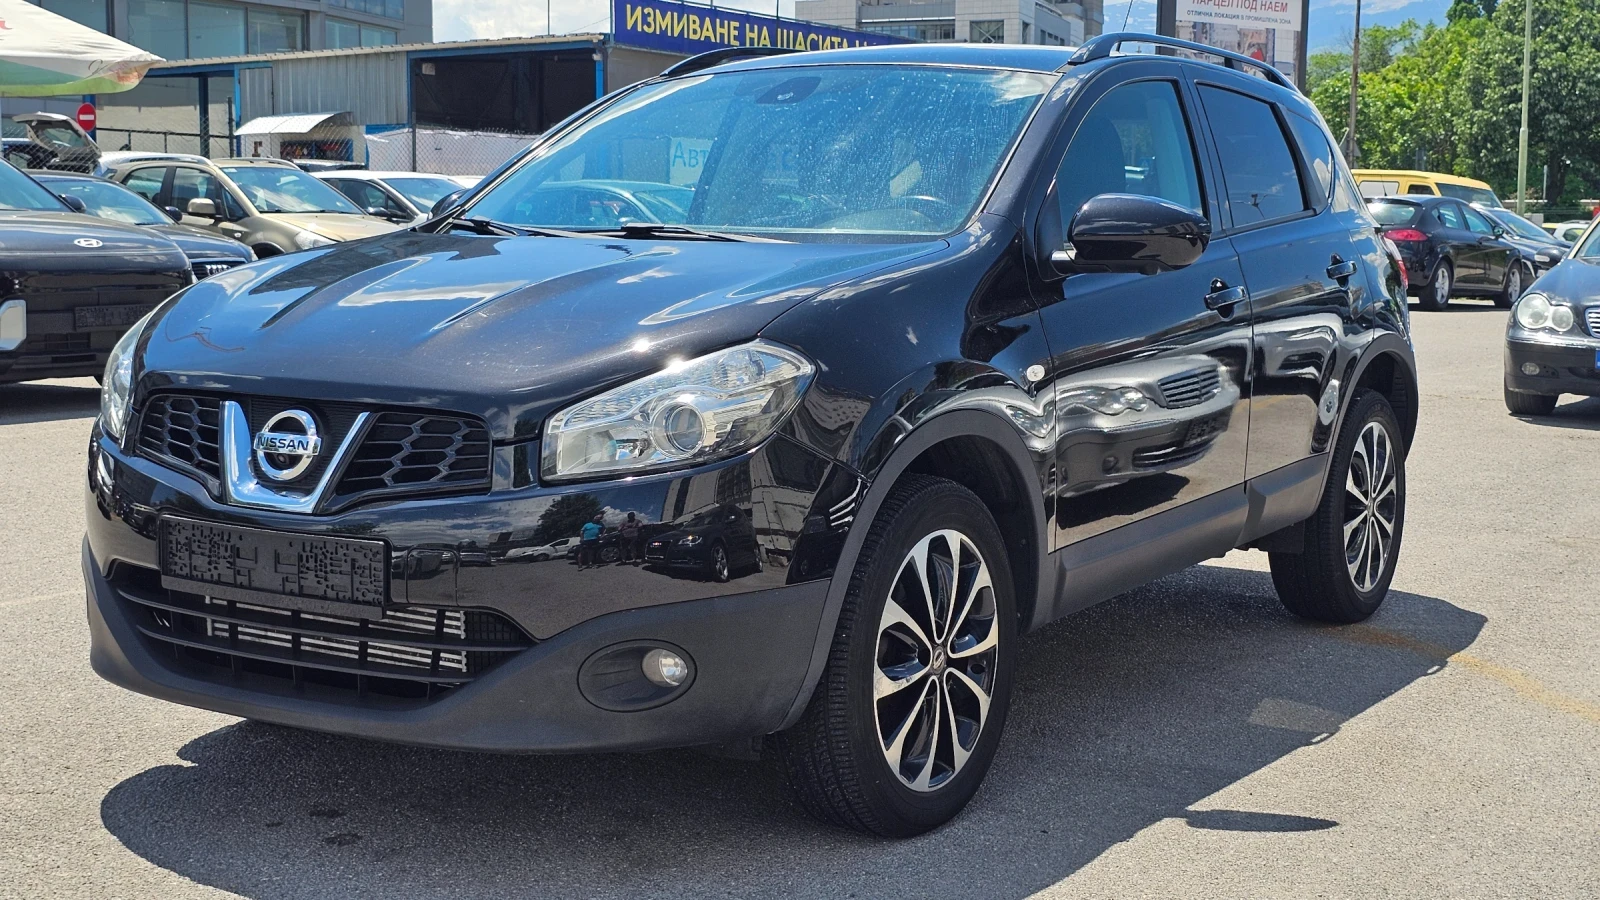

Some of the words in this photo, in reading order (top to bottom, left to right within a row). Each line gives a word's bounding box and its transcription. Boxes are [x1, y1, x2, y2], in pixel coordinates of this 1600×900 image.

[1236, 0, 1258, 12] ПОД
[1260, 1, 1288, 12] НАЕМ
[1214, 12, 1240, 20] ЛОКАЦИЯ
[626, 4, 740, 46] ИЗМИВАНЕ
[745, 23, 771, 48] НА
[257, 436, 309, 451] NISSAN
